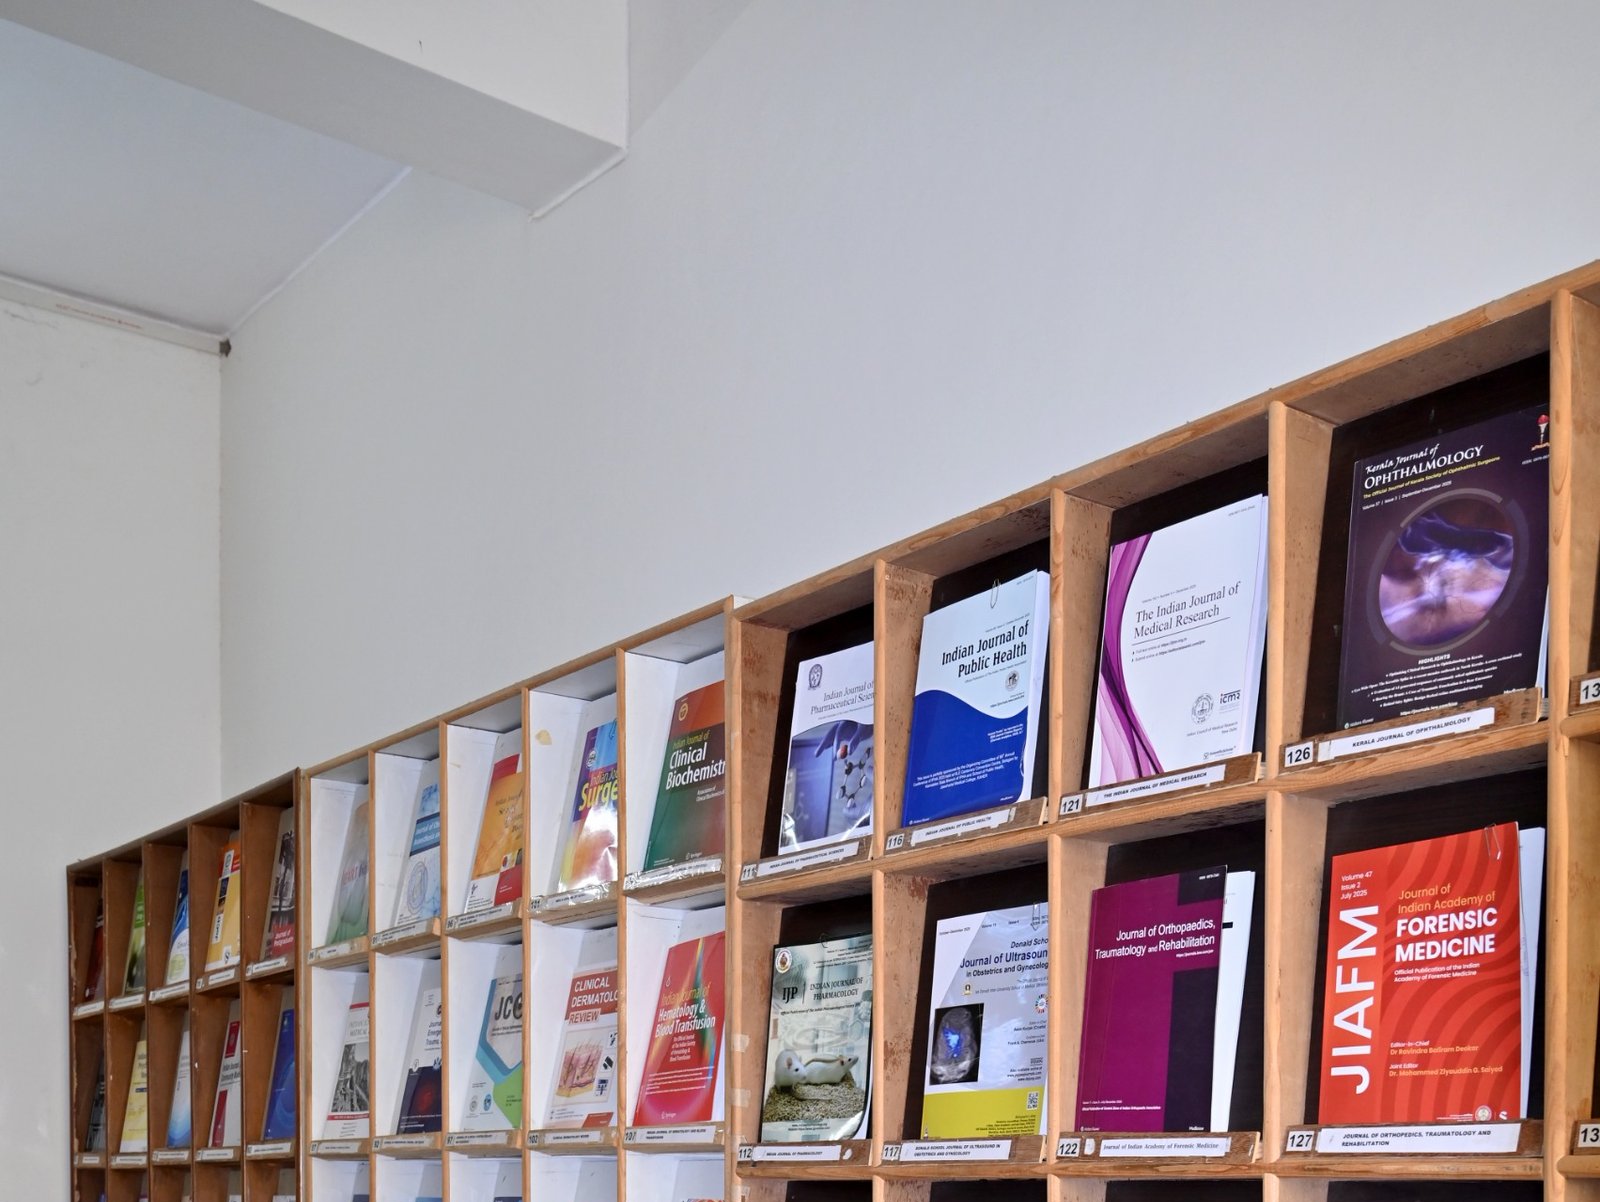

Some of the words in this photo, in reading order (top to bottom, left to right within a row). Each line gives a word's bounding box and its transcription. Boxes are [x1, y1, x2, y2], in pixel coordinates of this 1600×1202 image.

[1366, 457, 1393, 473] Kerala
[1396, 448, 1427, 468] Journal
[1428, 444, 1440, 457] of
[1364, 445, 1484, 490] OPHTHALMOLOGY
[1135, 609, 1155, 624] The
[1156, 602, 1187, 619] Indian
[1188, 590, 1225, 613] Journal
[1227, 581, 1242, 598] of
[1134, 622, 1173, 640] Medical
[1175, 604, 1220, 629] Research
[942, 643, 974, 666] Indian
[977, 628, 1015, 654] Journal
[1017, 620, 1029, 637] of
[958, 653, 990, 678] Public
[993, 642, 1027, 665] Health
[1352, 738, 1376, 747] KERALA
[1377, 732, 1404, 743] JOURNAL
[1416, 716, 1471, 736] OPHTHALMOLOGY
[1287, 747, 1310, 763] 126
[1062, 799, 1080, 813] 121
[887, 836, 903, 847] 116
[1341, 872, 1364, 882] Volume
[1341, 891, 1353, 900] July
[1354, 889, 1367, 898] 2025
[1399, 884, 1438, 900] Journal
[1440, 883, 1451, 894] of
[1398, 900, 1432, 914] Indian
[1434, 894, 1483, 912] Academy
[1485, 891, 1495, 903] of
[1116, 928, 1146, 942] Journal
[1148, 927, 1157, 937] of
[1158, 919, 1216, 938] Orthopaedics,
[1397, 907, 1498, 937] FORENSIC
[1011, 939, 1032, 949] Donald
[1095, 943, 1146, 960] Traumatology
[1148, 945, 1158, 953] and
[1159, 934, 1215, 951] Rehabilitation
[1395, 934, 1495, 963] MEDICINE
[960, 958, 992, 969] Journal
[994, 954, 1003, 963] of
[973, 966, 1002, 977] Obstetrics
[1004, 965, 1015, 973] and
[783, 987, 798, 1004] IJP
[813, 989, 858, 1000] PHARMACOLOGY
[1331, 905, 1379, 1095] JIAFM
[1289, 1134, 1313, 1148] 127
[1380, 1131, 1424, 1139] ORTHOPEDICS,
[739, 1148, 752, 1158] 112
[884, 1146, 900, 1158] 117
[1059, 1143, 1078, 1155] 122
